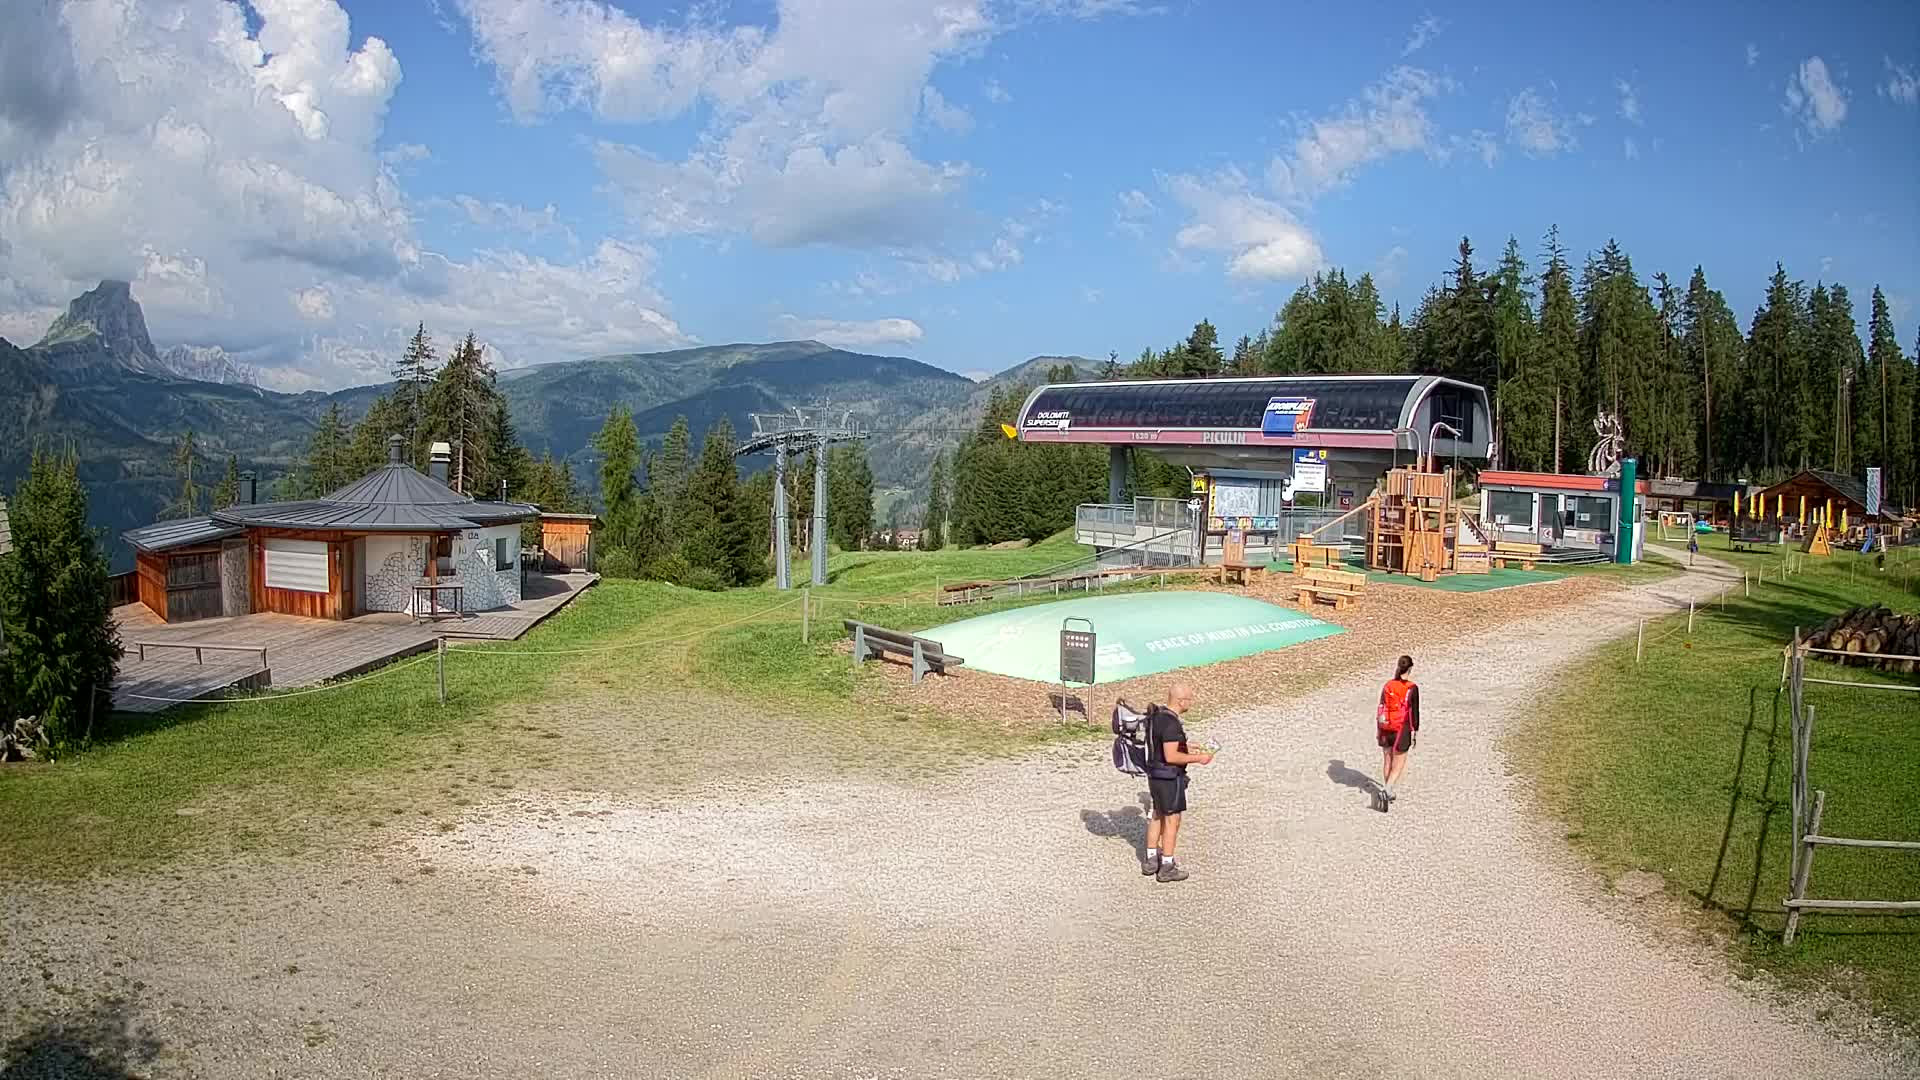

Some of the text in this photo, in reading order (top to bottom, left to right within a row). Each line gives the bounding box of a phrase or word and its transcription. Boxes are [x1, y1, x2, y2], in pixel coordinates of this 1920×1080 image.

[1203, 432, 1245, 444] PICULIN
[1146, 635, 1190, 653] PEACE
[1189, 632, 1205, 646] OF
[1204, 629, 1235, 643] MIND
[1233, 626, 1250, 638] IN
[1248, 623, 1270, 635] ALL
